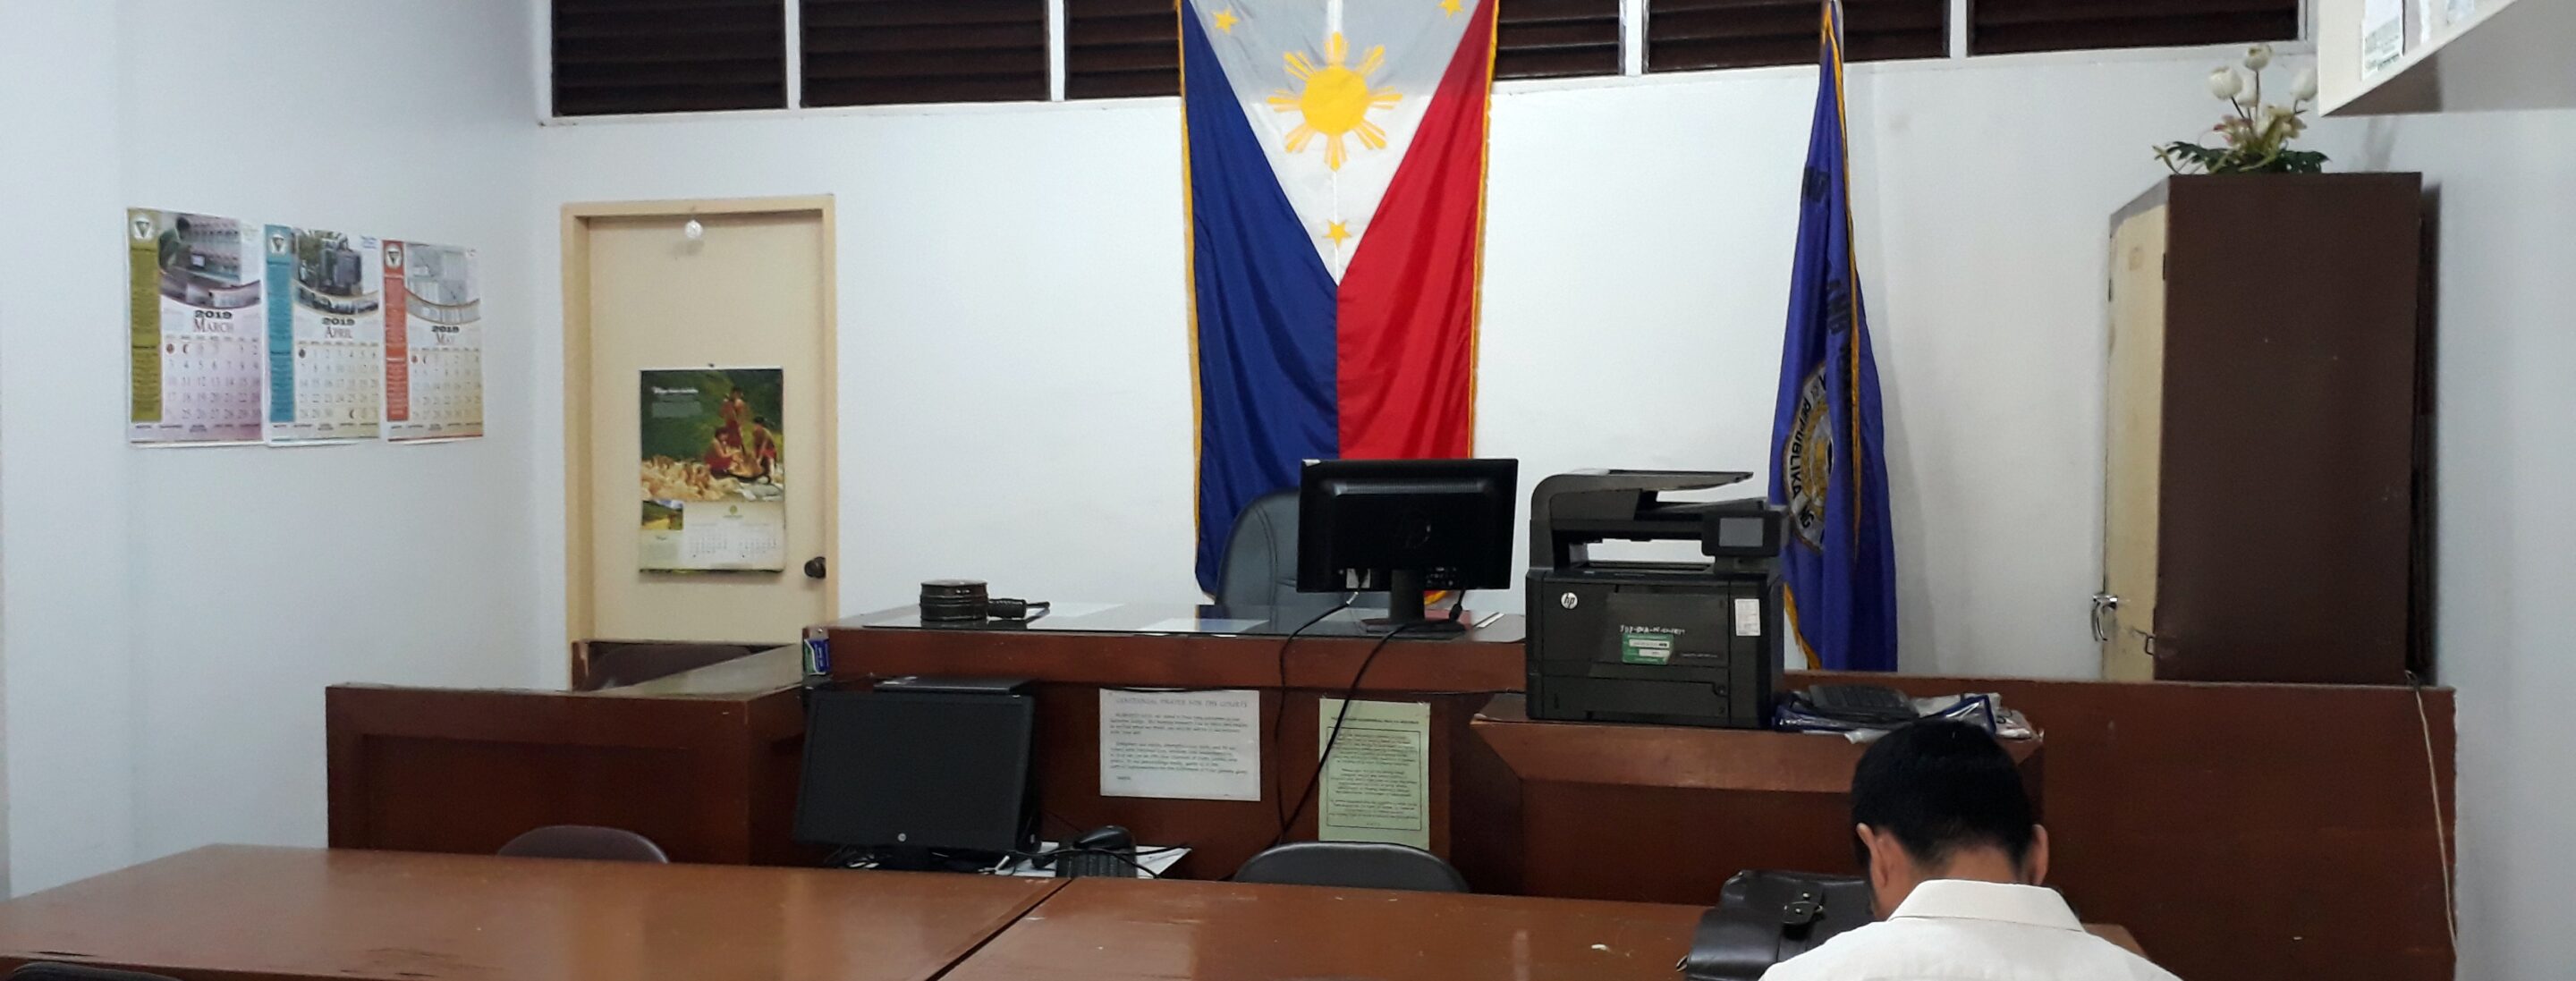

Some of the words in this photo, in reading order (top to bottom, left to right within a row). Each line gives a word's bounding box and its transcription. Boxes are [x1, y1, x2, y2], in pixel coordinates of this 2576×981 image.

[195, 309, 233, 319] 2019
[322, 317, 355, 326] 2019
[1790, 396, 1811, 500] REPUBLIKA
[1563, 592, 1577, 609] hp
